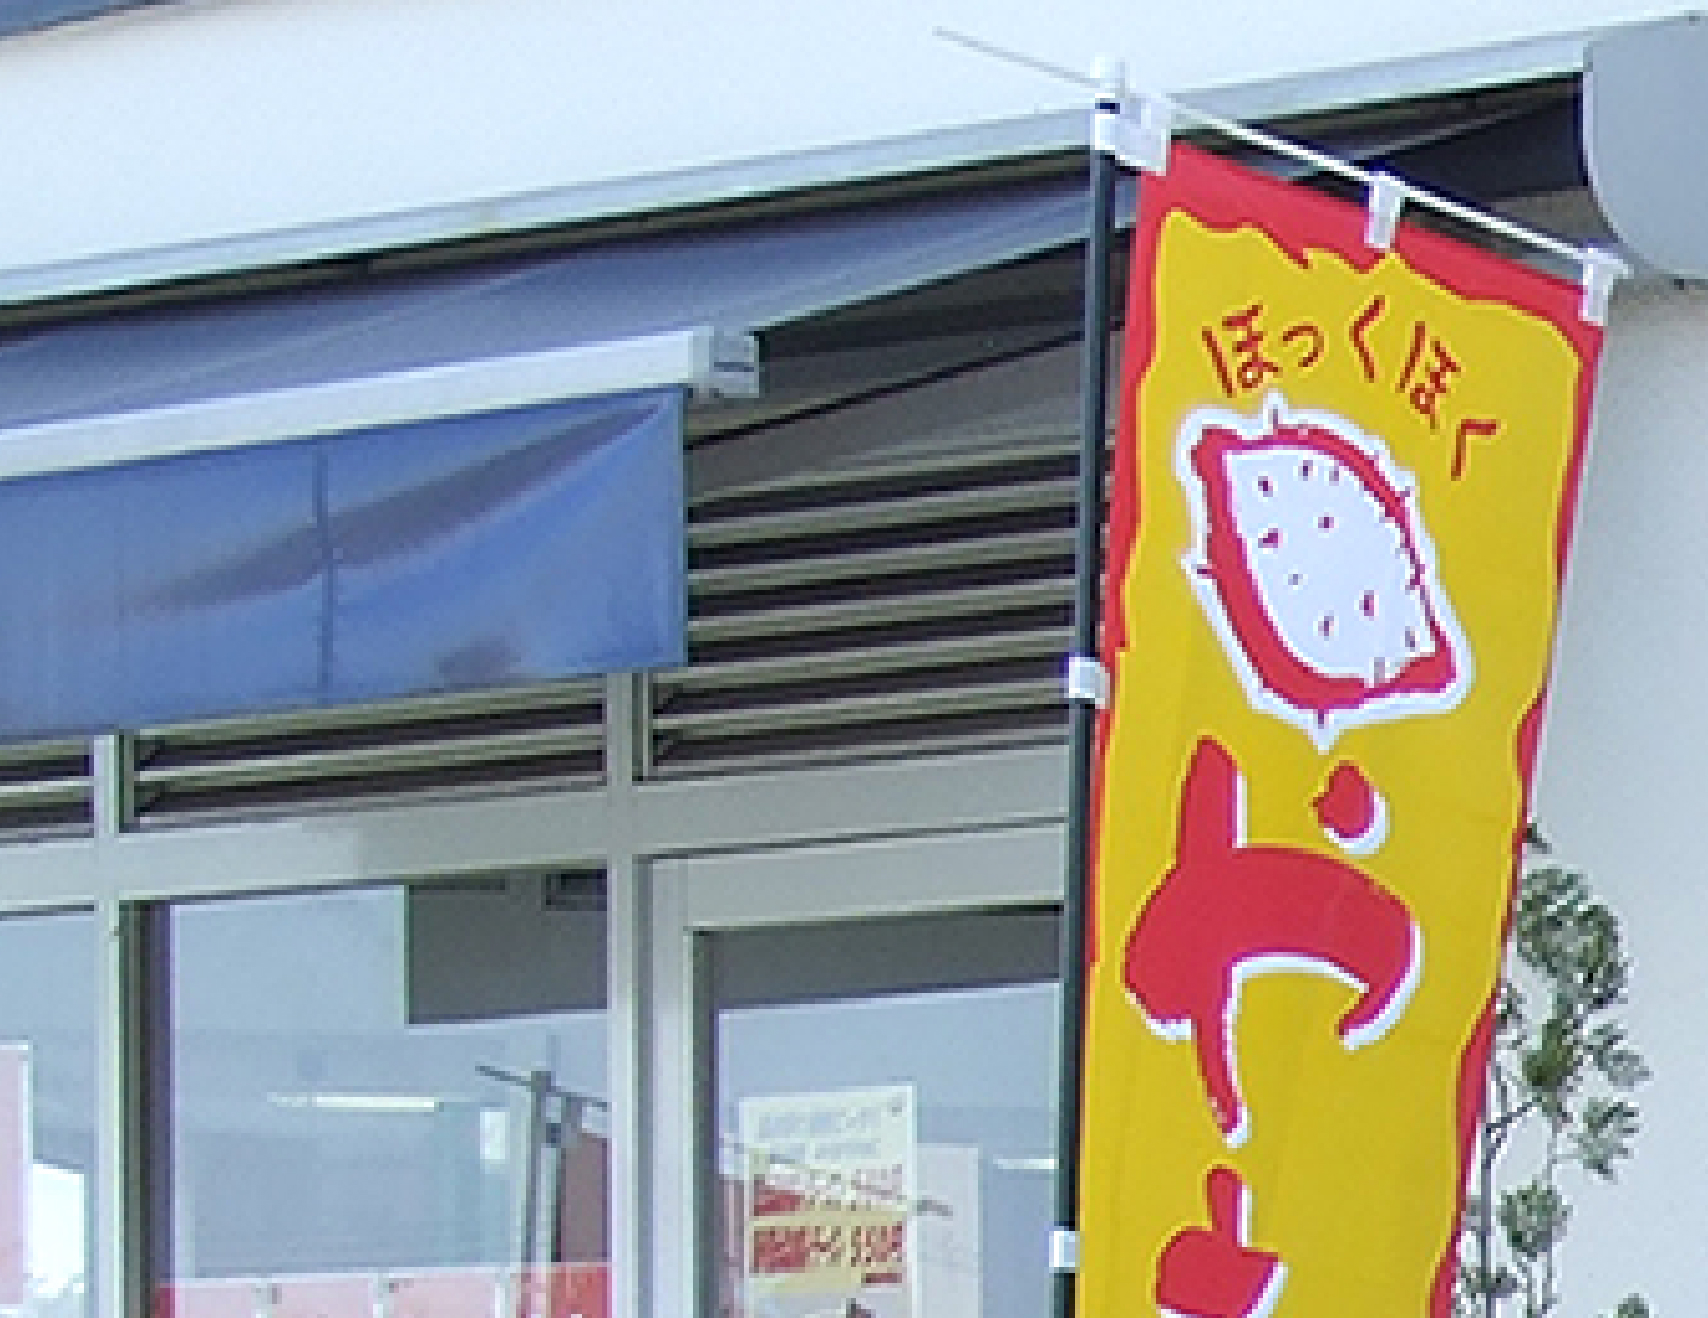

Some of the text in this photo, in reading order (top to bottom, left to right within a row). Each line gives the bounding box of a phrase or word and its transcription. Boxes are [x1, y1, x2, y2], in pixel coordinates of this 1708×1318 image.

[1200, 297, 1498, 480] ほっくほく
